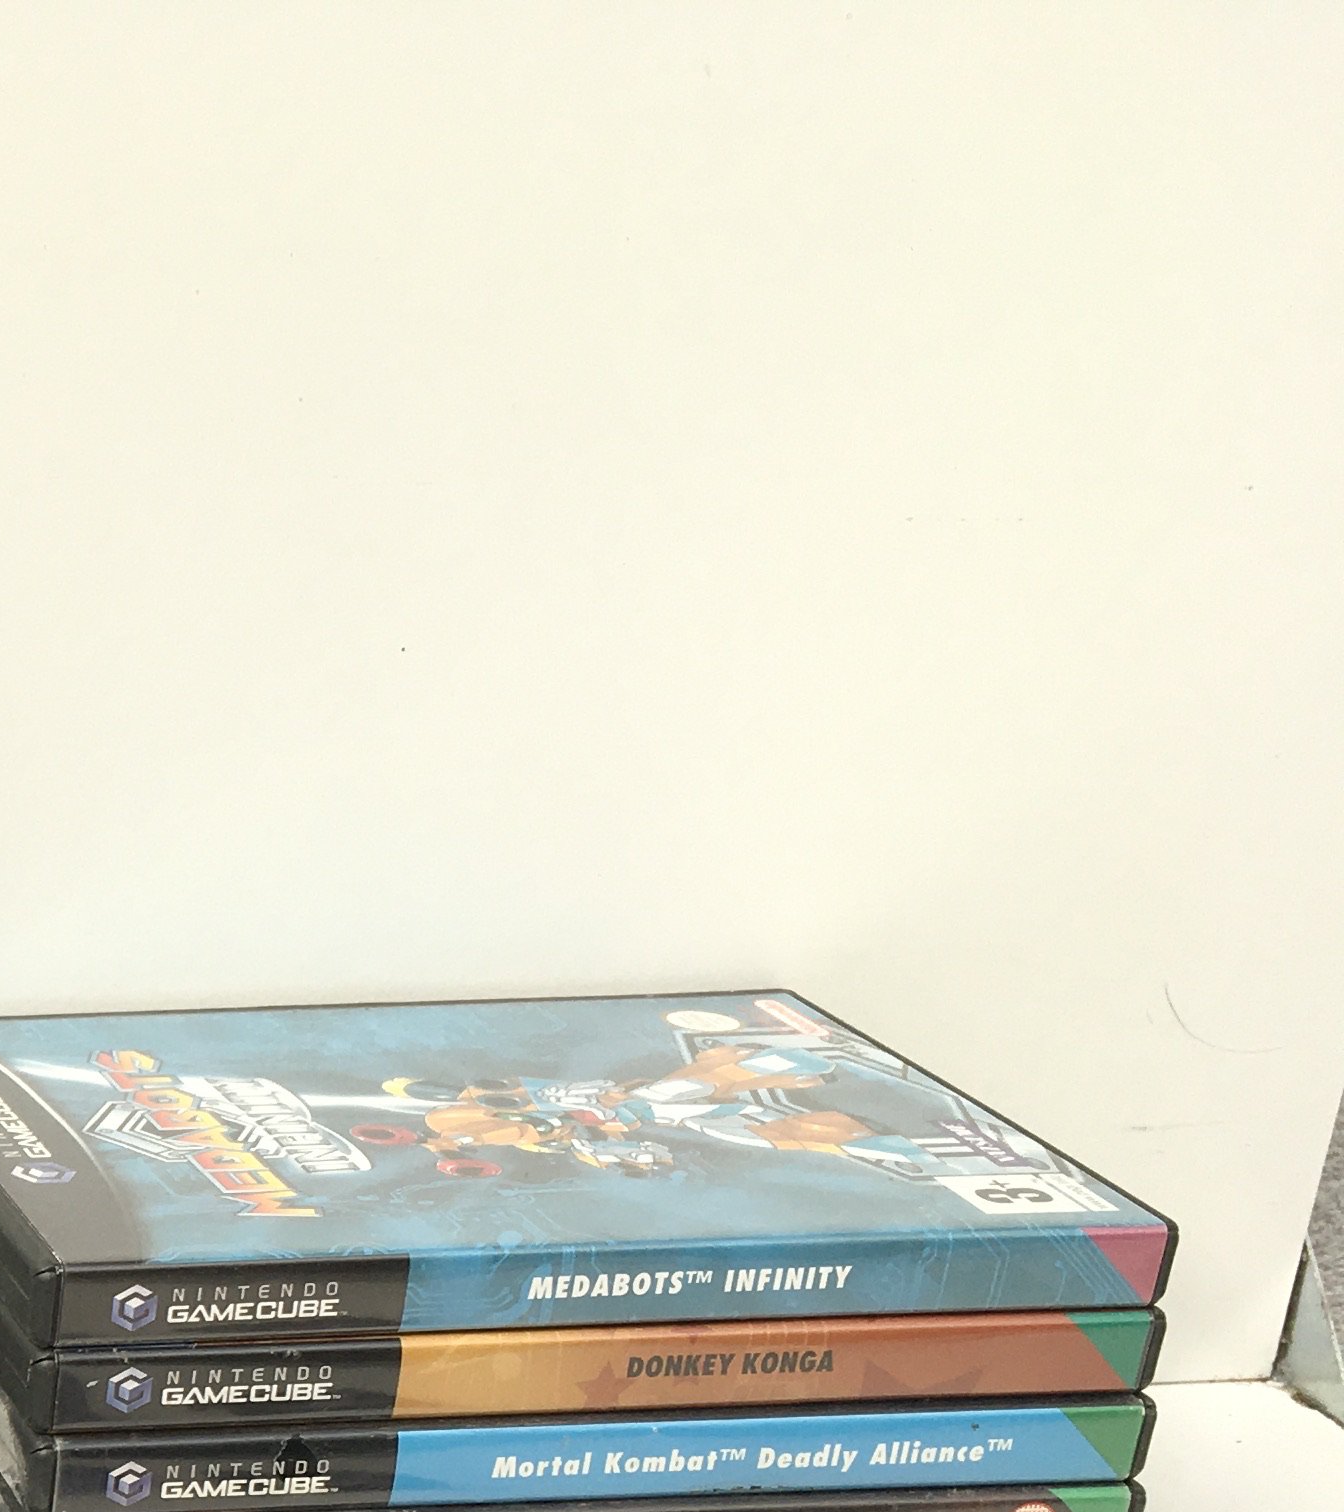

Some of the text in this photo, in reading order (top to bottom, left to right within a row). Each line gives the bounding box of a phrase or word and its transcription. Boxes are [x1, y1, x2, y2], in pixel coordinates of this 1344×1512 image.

[87, 1049, 324, 1217] MEDABOTS
[208, 1077, 362, 1173] INFINITY
[172, 1281, 339, 1302] NINTENDO
[723, 1265, 853, 1293] INFINITY
[166, 1365, 333, 1385] NINTENDO
[626, 1349, 834, 1378] DONKEY KONGA
[165, 1458, 331, 1480] NINTENDO
[491, 1451, 593, 1479] Mortal
[756, 1442, 859, 1473] Deadly
